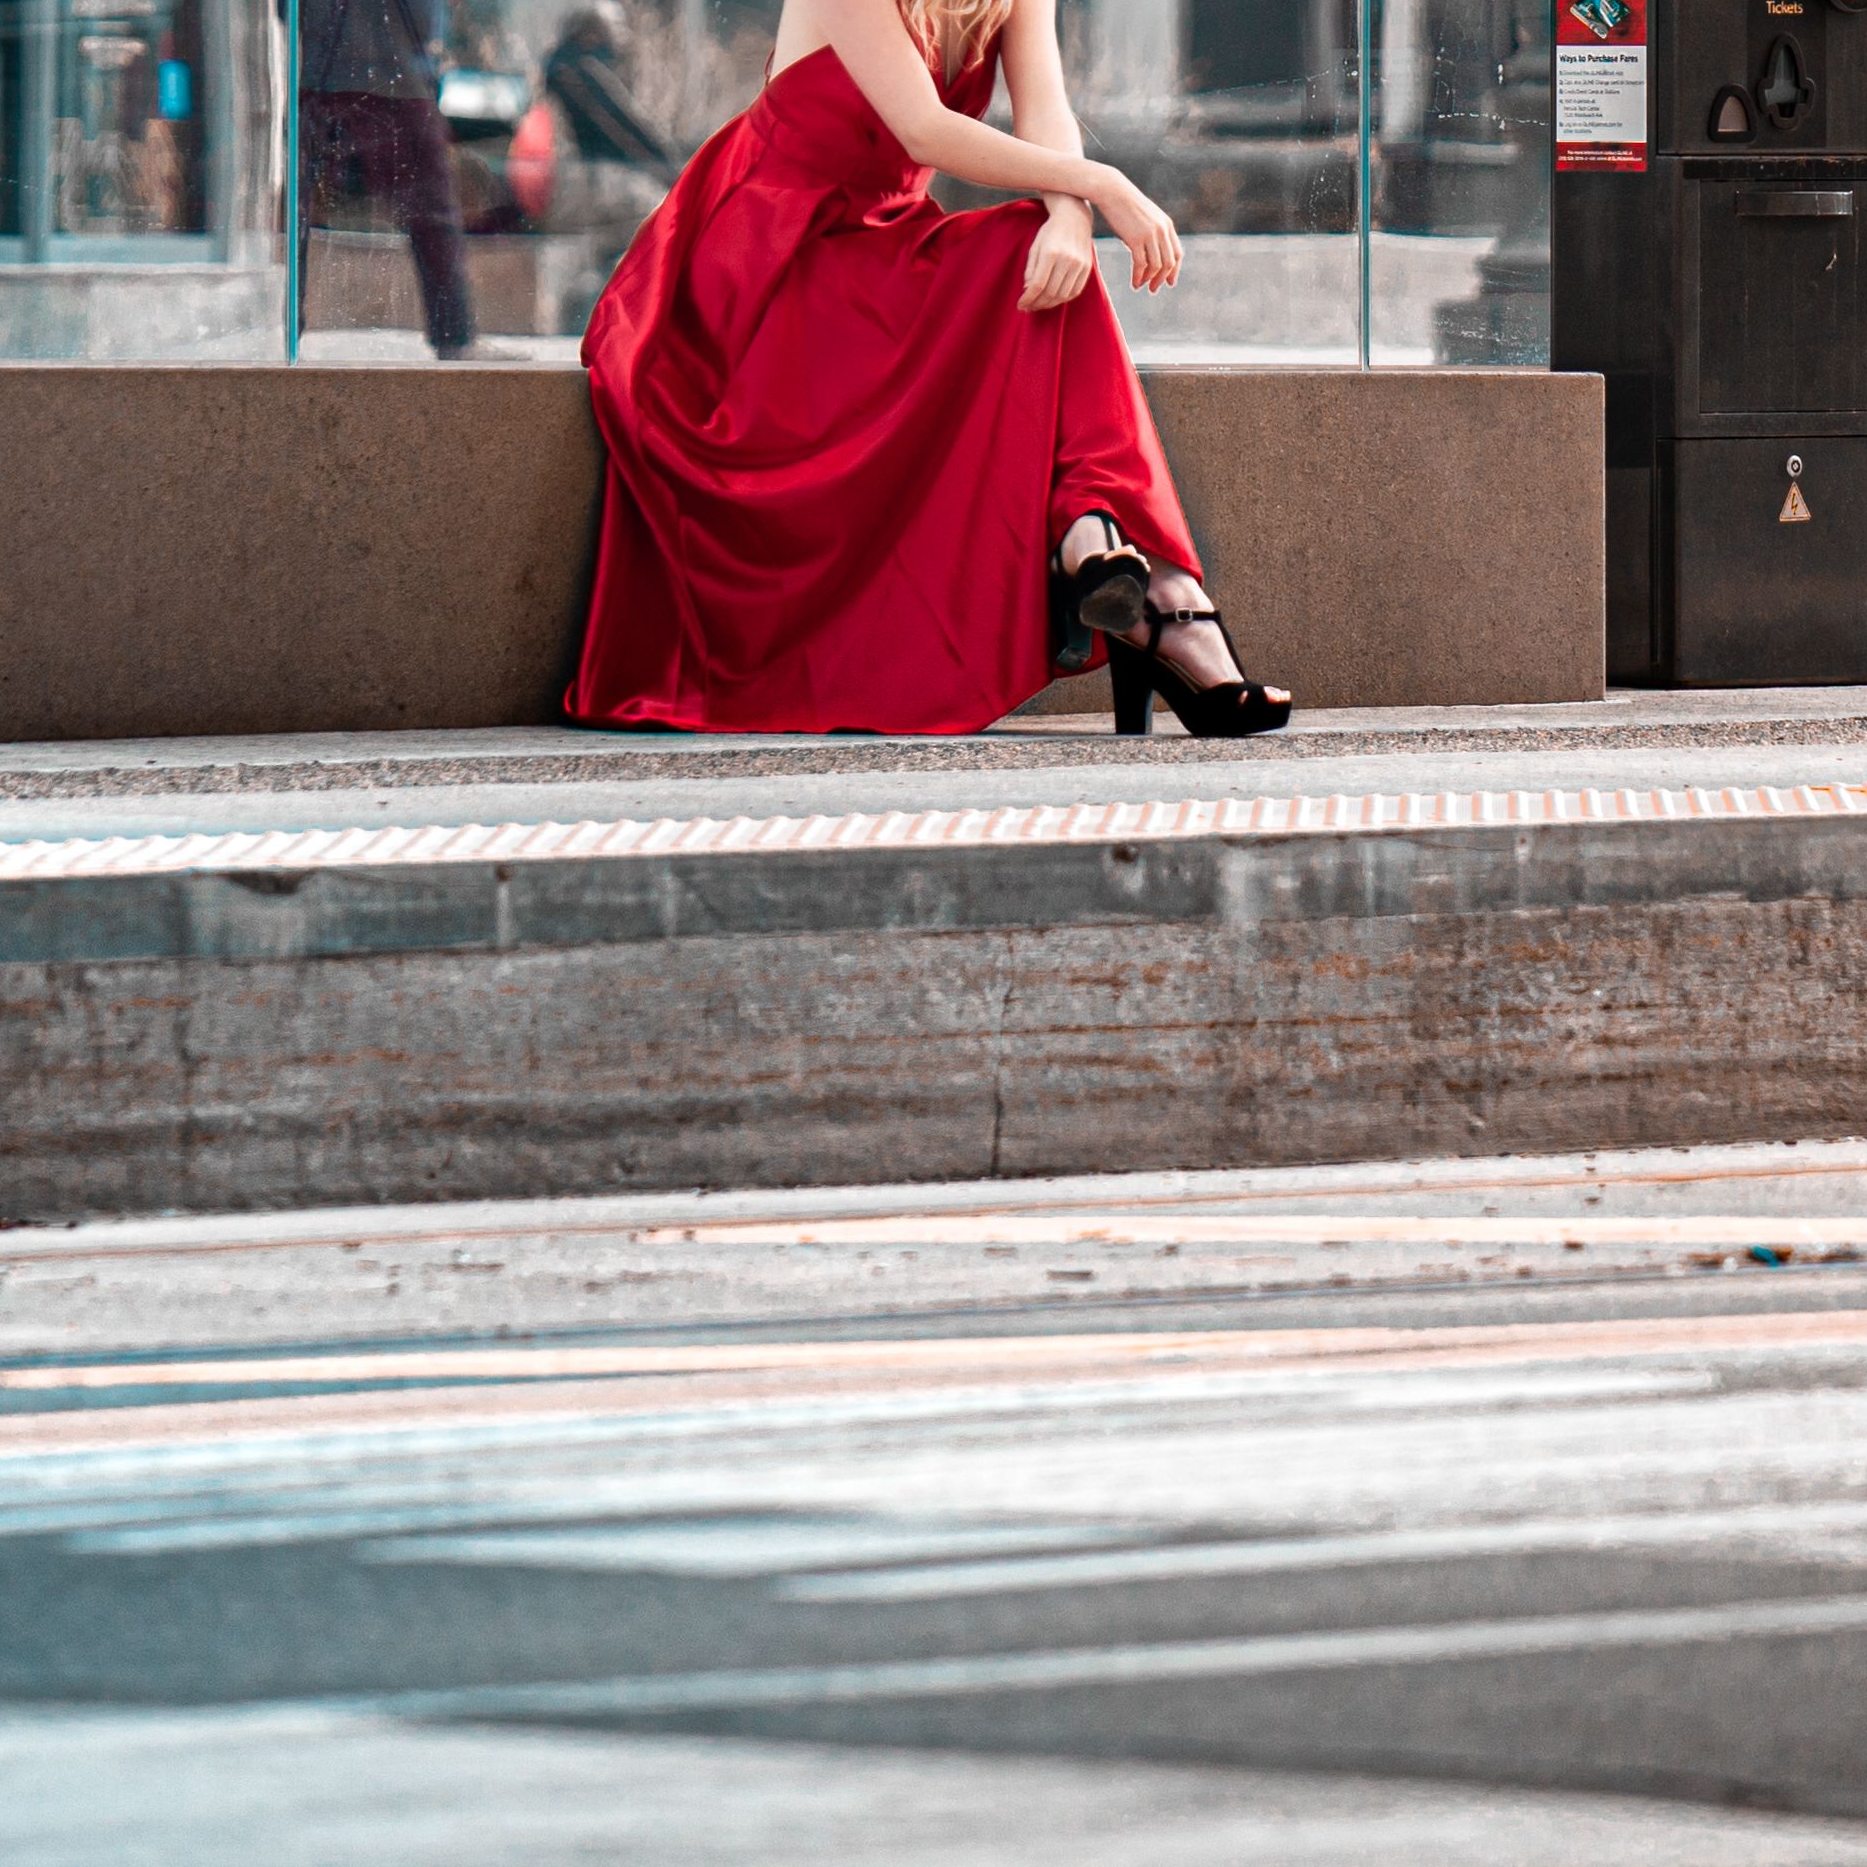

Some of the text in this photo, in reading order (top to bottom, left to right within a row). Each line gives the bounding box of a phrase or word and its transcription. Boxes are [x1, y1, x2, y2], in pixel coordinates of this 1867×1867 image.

[1766, 0, 1804, 15] Tickets
[1559, 54, 1639, 64] Ways to Purchase Fares
